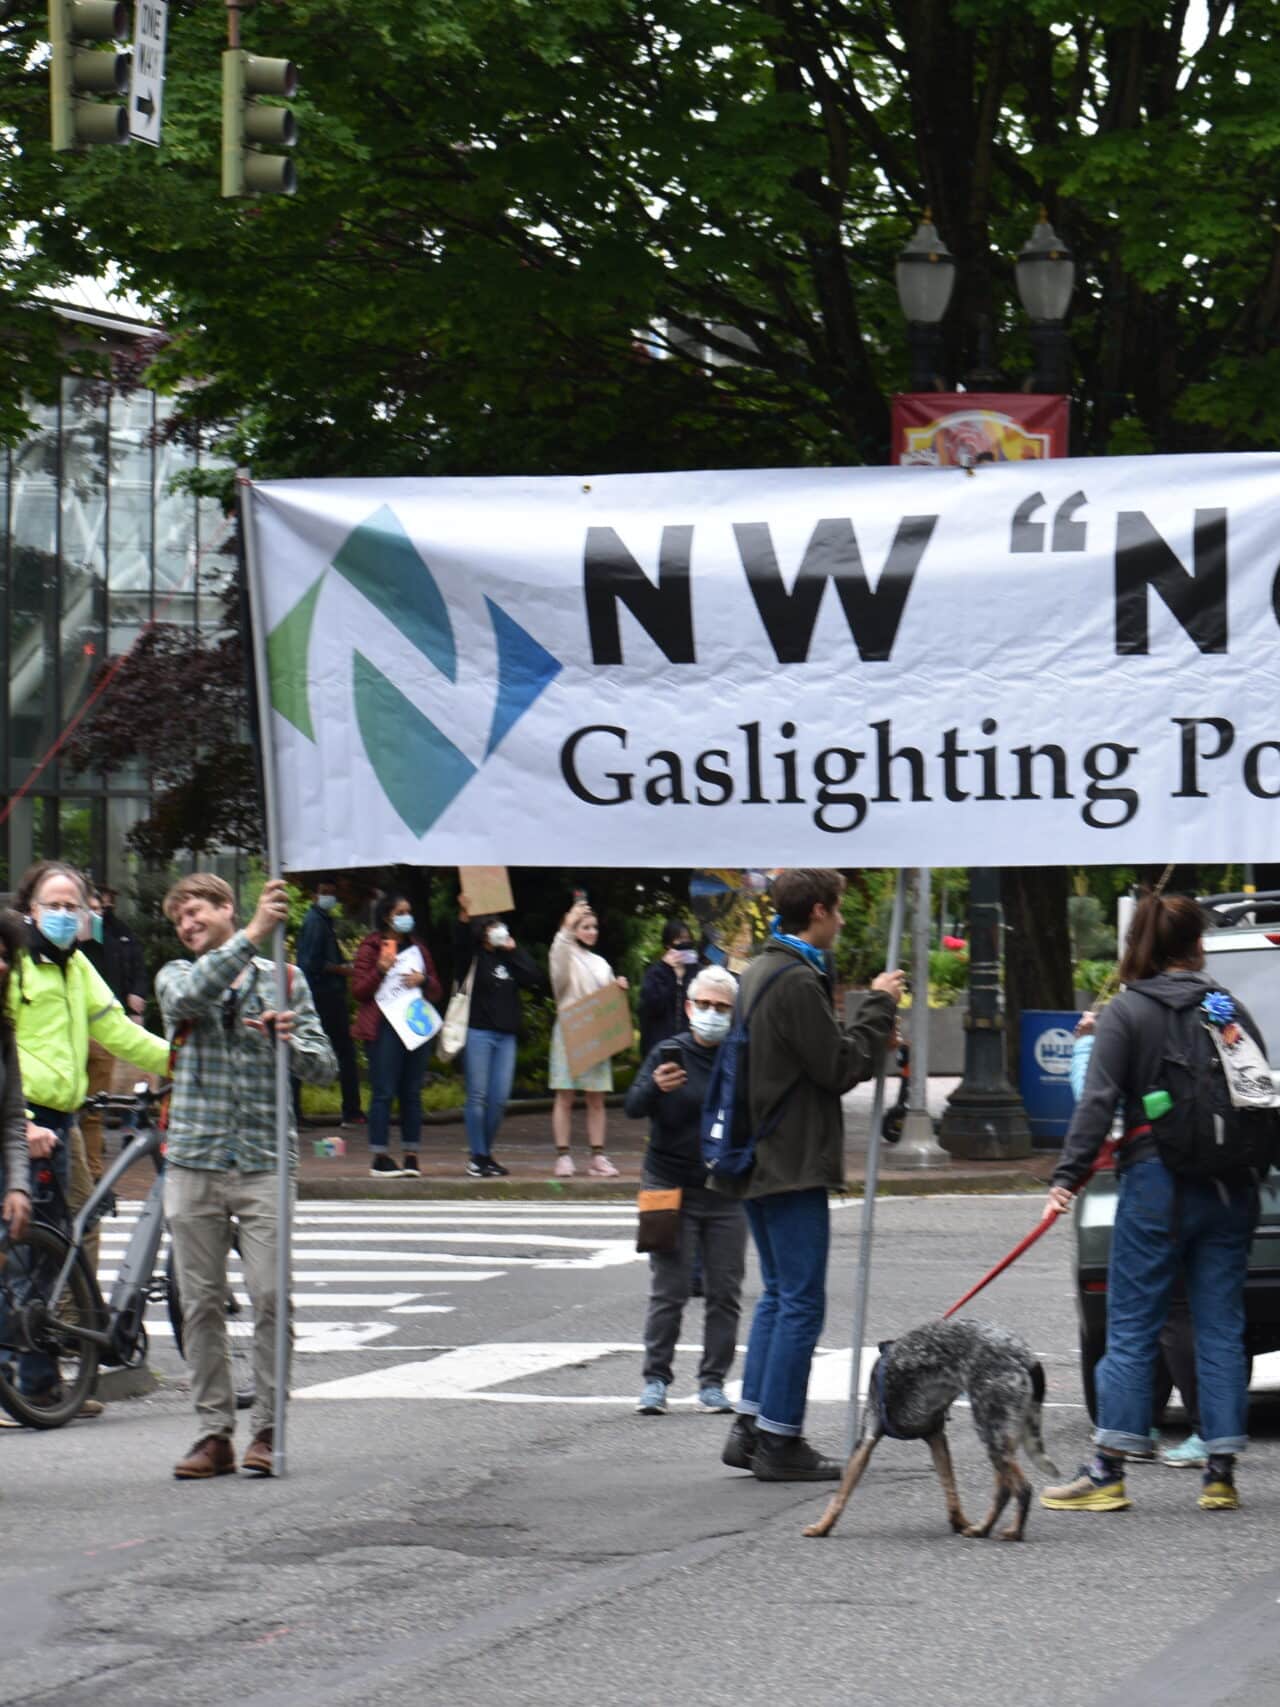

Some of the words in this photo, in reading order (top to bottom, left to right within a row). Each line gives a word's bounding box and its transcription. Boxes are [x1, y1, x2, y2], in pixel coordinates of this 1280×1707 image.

[141, 3, 162, 41] ONE
[583, 514, 939, 666] NW
[559, 717, 1139, 834] Gaslighting
